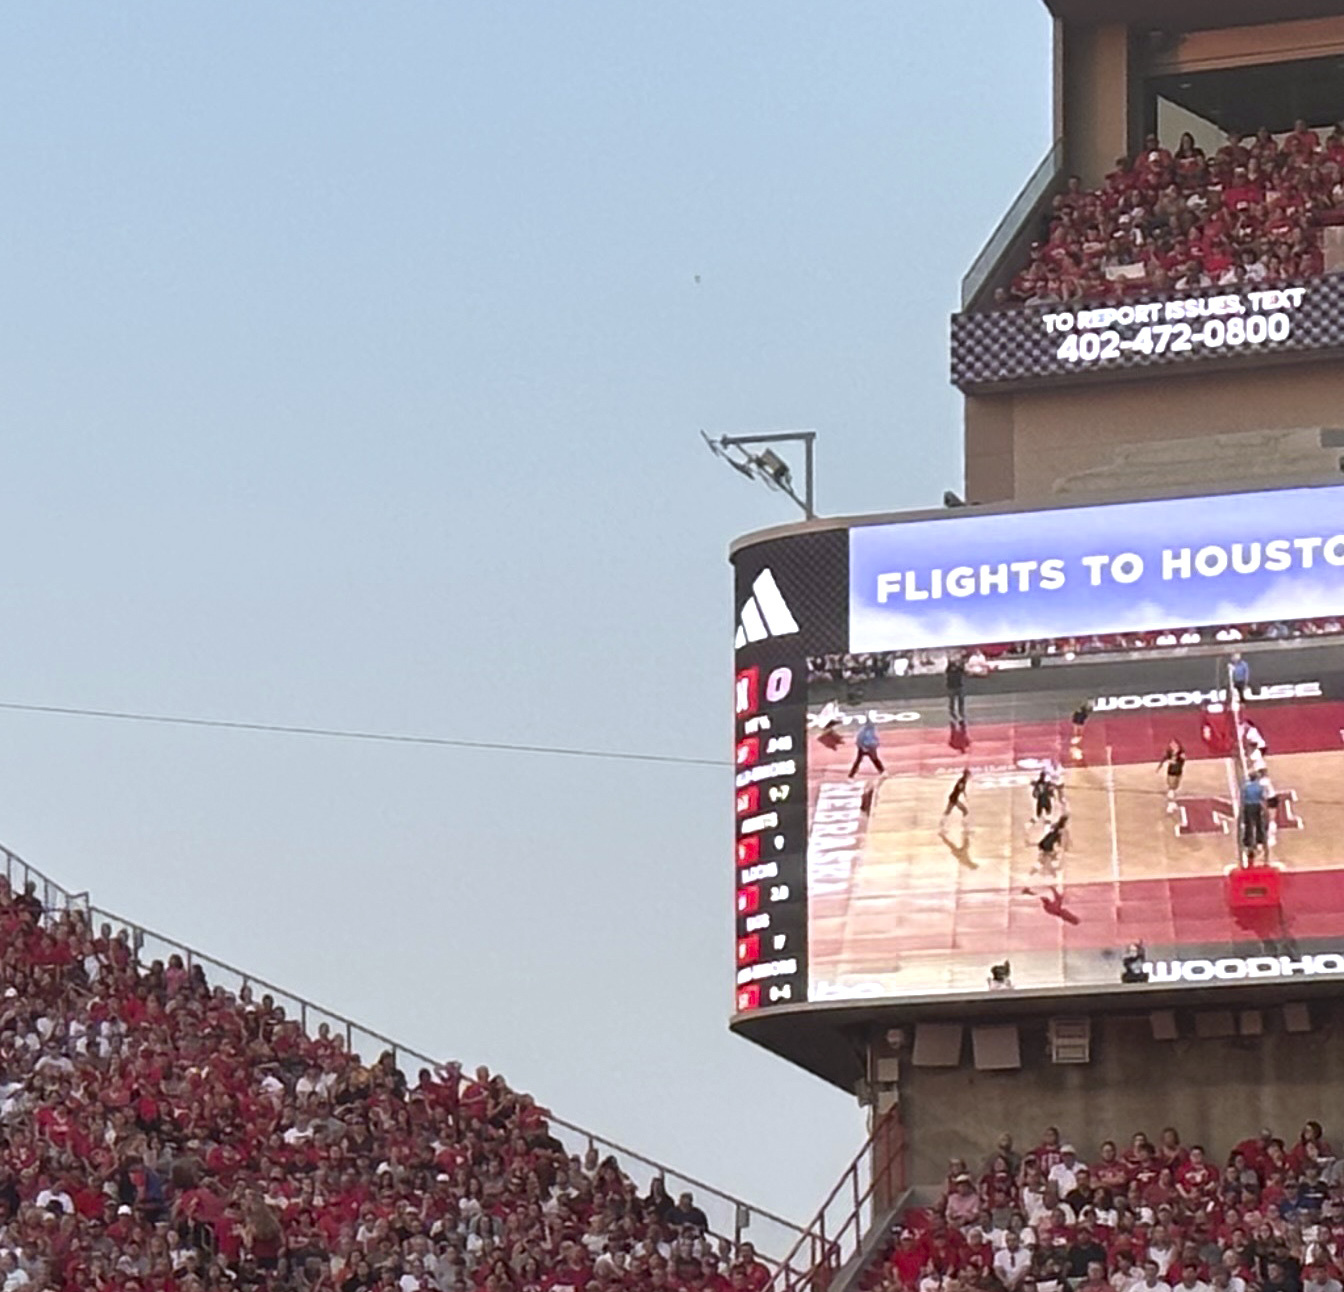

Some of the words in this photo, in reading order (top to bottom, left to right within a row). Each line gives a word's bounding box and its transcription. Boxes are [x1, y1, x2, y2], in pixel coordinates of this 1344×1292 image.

[1043, 311, 1074, 334] TO
[1076, 303, 1163, 329] REPORT
[1165, 294, 1246, 320] ISSUES,
[1248, 287, 1307, 311] TEXT
[1057, 312, 1290, 363] 402-472-0800
[877, 559, 1066, 603] FLIGHTS
[1082, 553, 1144, 586] TO
[1092, 681, 1323, 711] WOODHUSE
